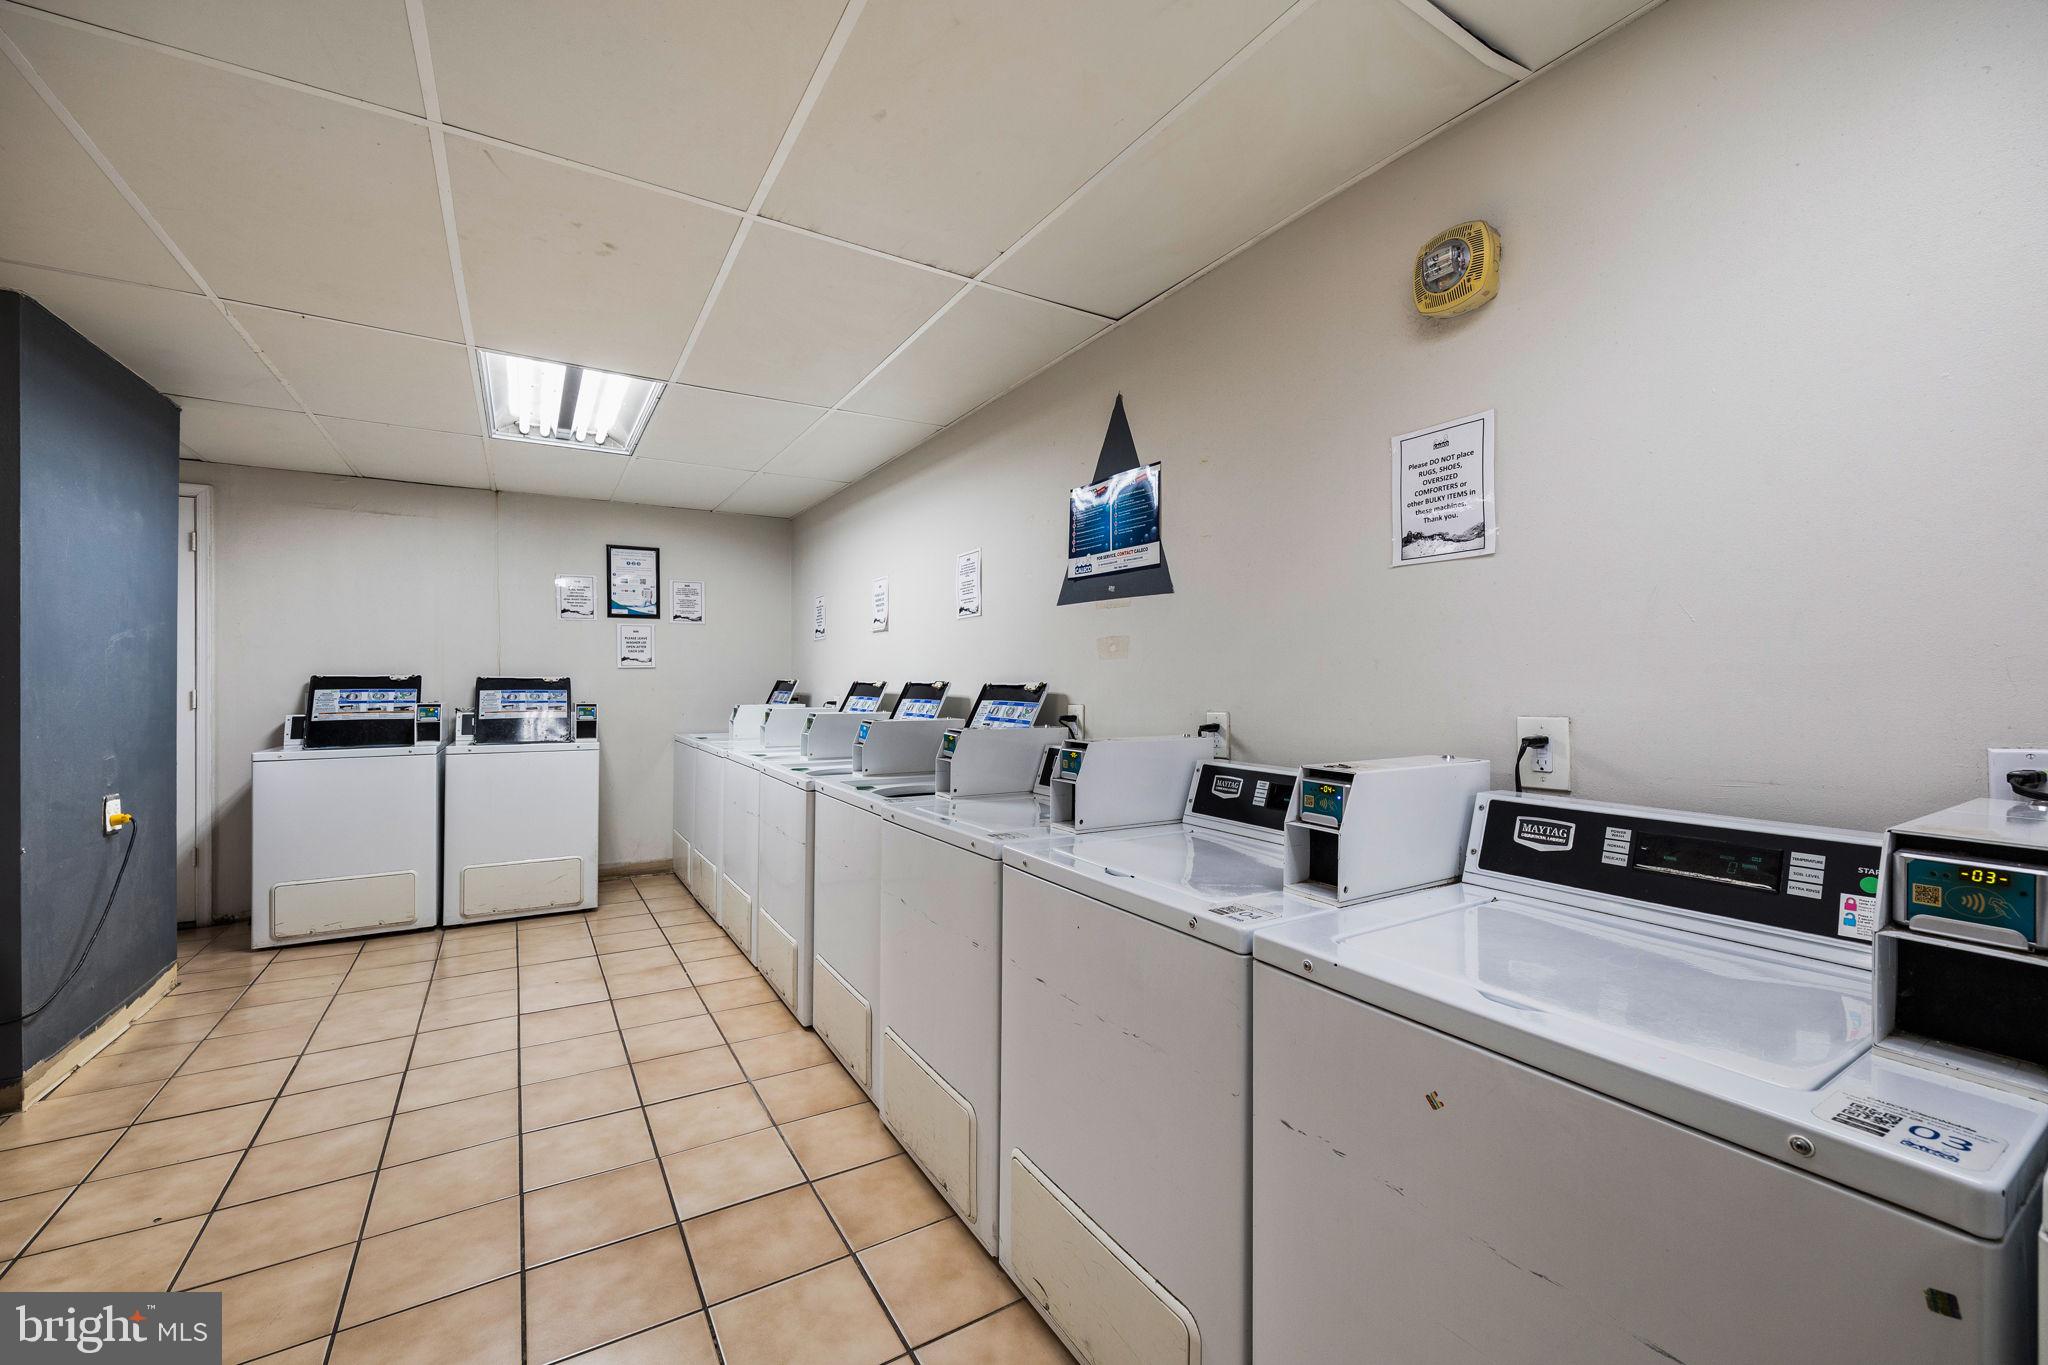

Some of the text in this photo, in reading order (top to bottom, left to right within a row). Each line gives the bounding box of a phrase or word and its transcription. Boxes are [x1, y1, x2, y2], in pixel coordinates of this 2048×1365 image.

[1408, 450, 1475, 471] Please DO NOT place
[1418, 462, 1463, 478] RUGS, SHOES,
[1422, 472, 1458, 486] OVERSIZED
[1414, 482, 1459, 497] COMFORTERS
[1407, 499, 1424, 508] other
[1425, 494, 1446, 504] BULKY
[1447, 489, 1468, 500] ITEMS
[1415, 501, 1467, 516] these machines.
[1423, 513, 1459, 524] Thank you.
[1217, 780, 1240, 789] MAYTAG
[1522, 823, 1568, 838] MAYTAG
[1792, 856, 1824, 865] TEMPERATURE
[1908, 1125, 1973, 1152] 03
